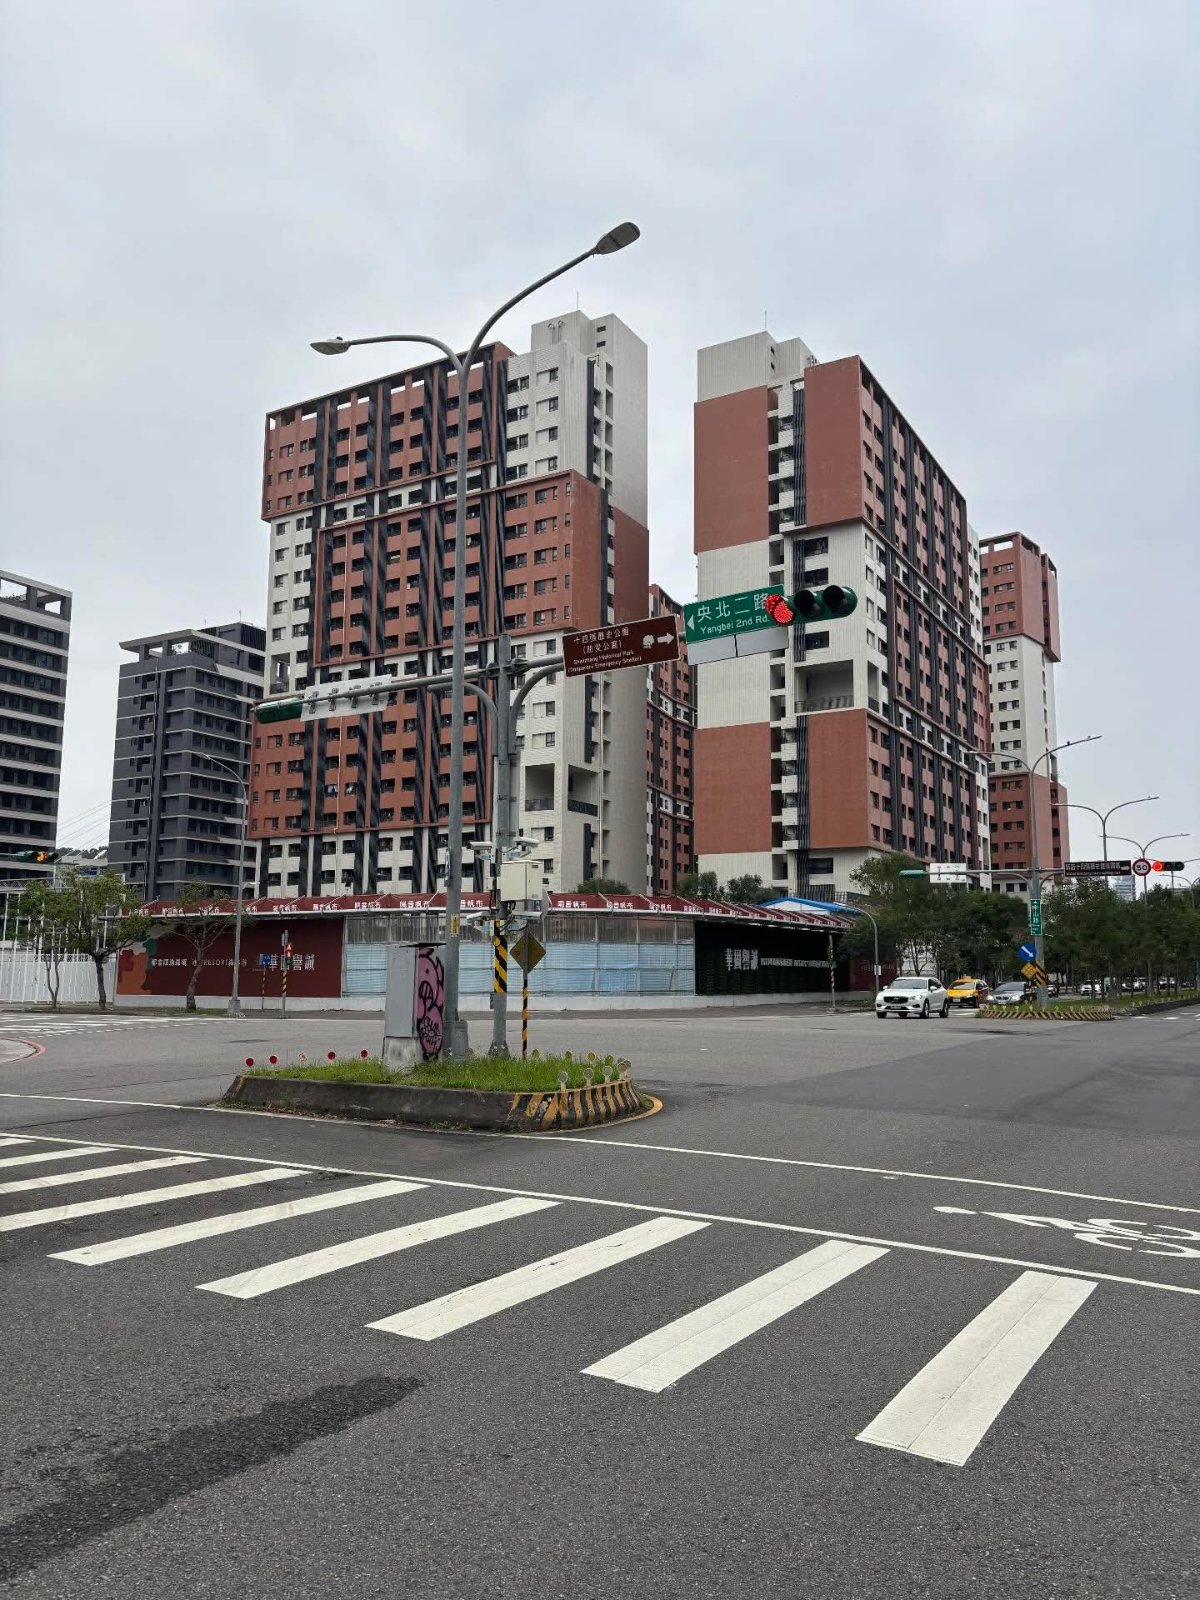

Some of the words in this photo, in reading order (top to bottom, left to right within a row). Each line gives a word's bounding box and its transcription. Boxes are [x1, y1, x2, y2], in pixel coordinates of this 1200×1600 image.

[697, 593, 769, 622] 央北二路
[700, 622, 734, 635] Yangbei
[736, 618, 753, 628] 2nd
[755, 614, 770, 623] Rd.
